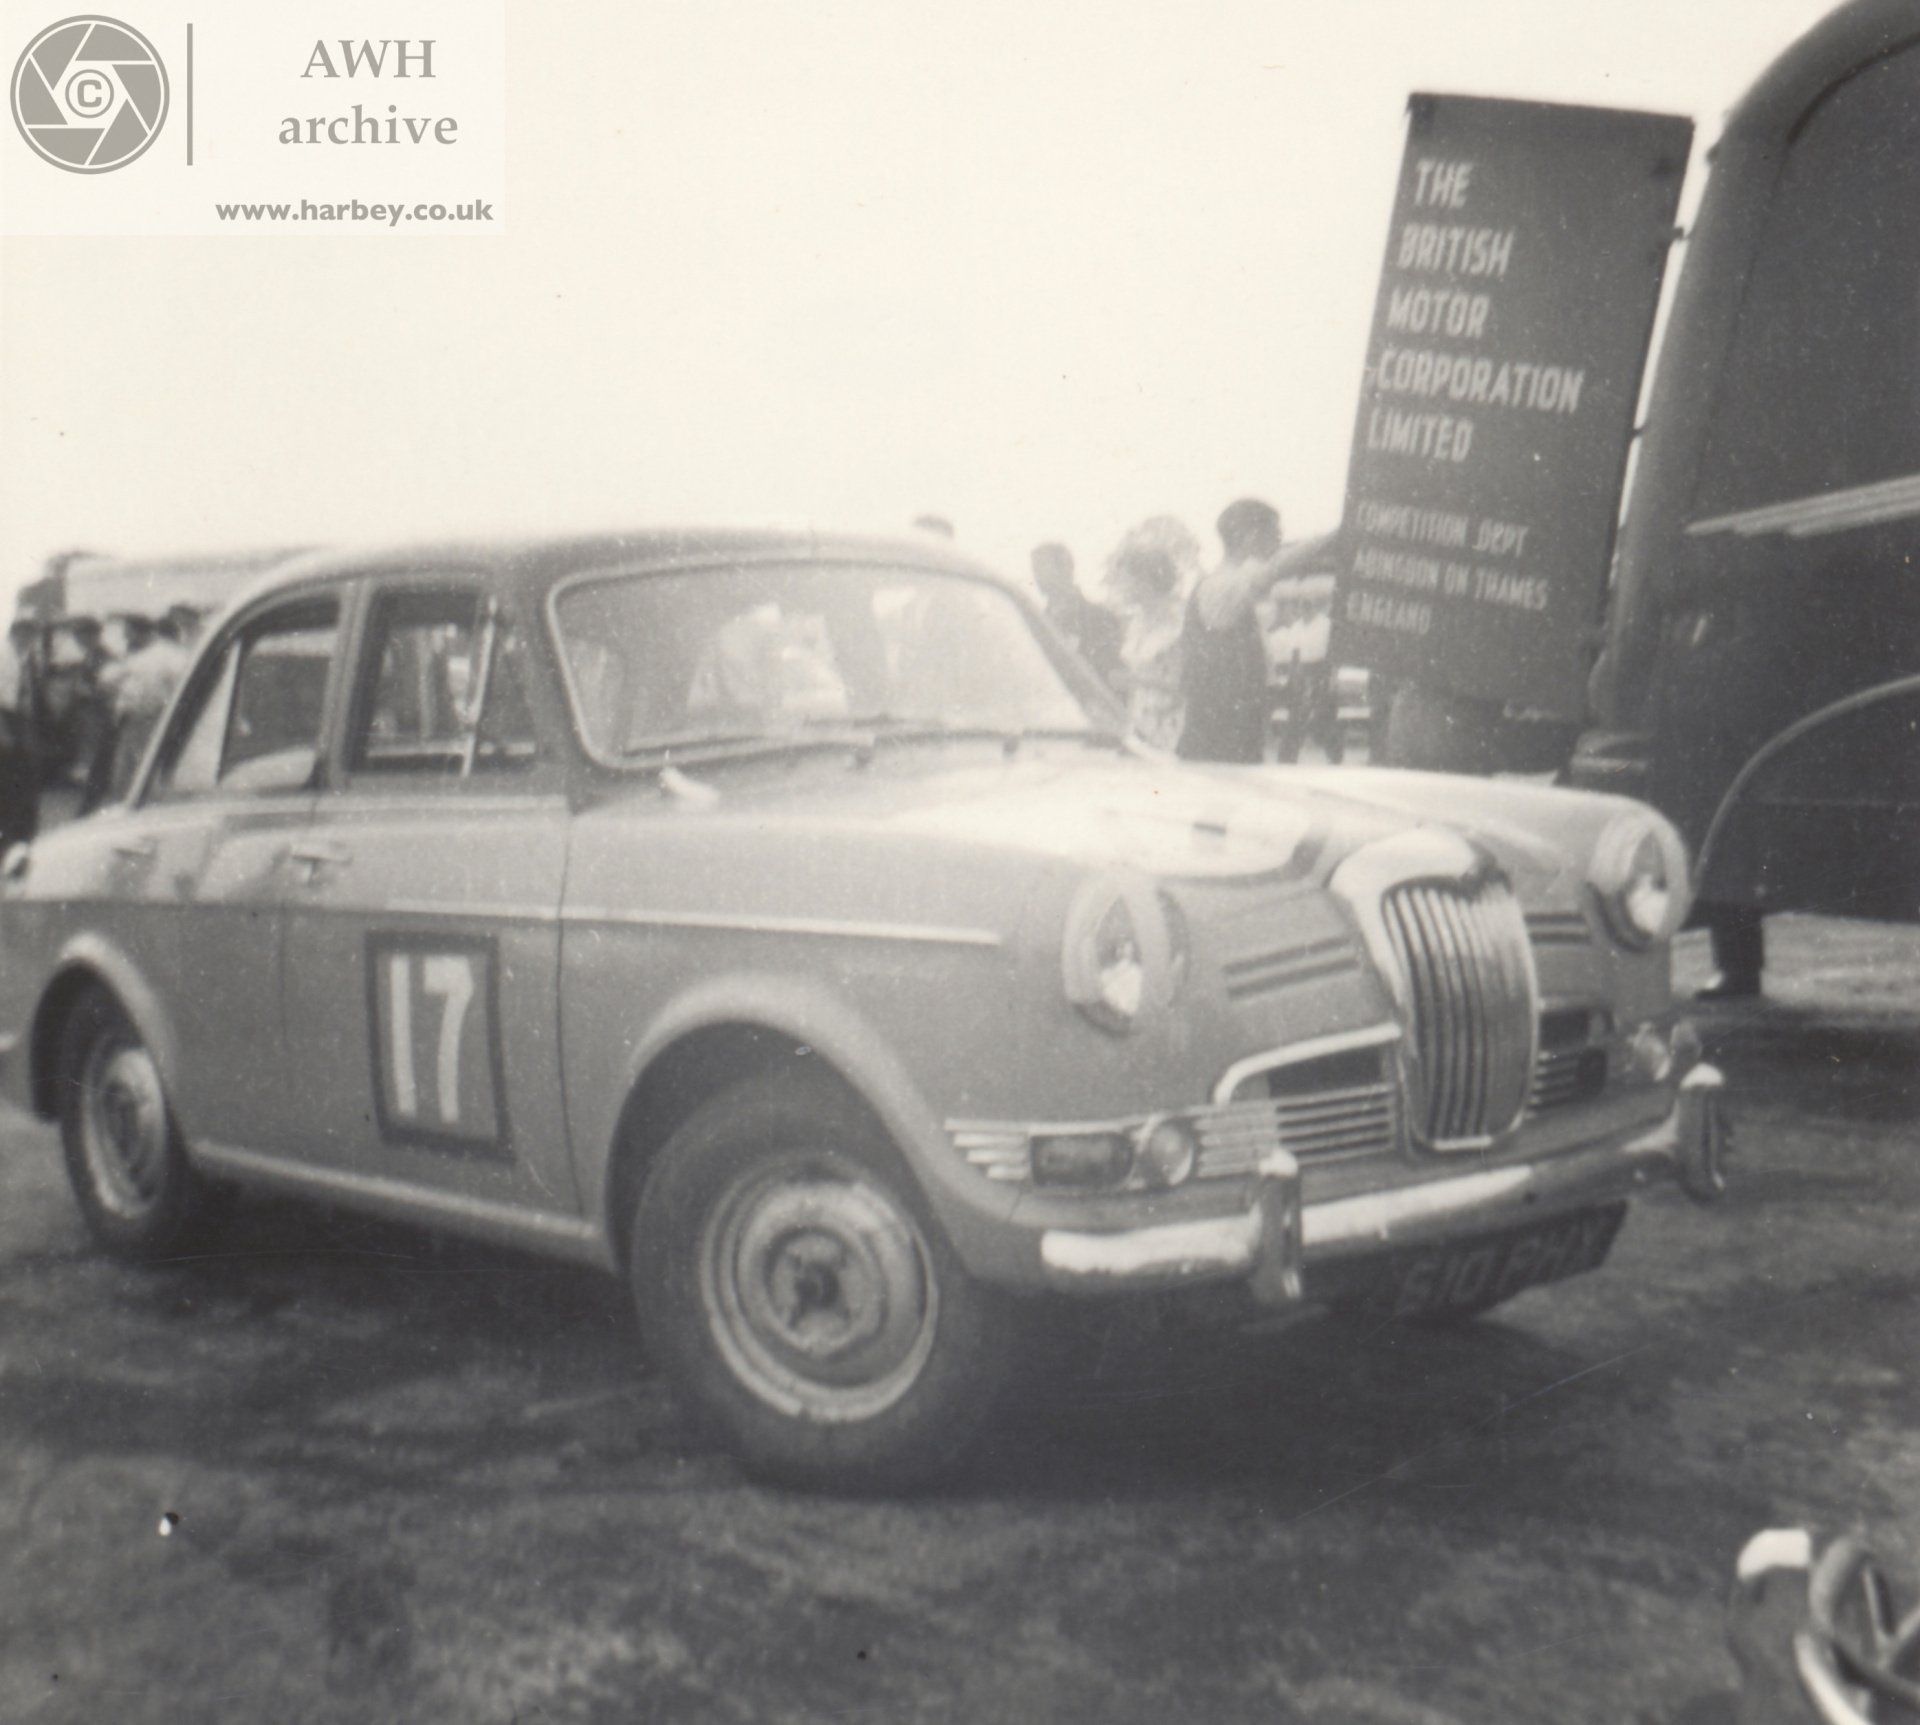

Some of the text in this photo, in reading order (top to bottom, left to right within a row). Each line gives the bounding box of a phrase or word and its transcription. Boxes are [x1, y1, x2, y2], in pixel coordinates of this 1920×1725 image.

[1413, 159, 1474, 209] THE
[1397, 221, 1515, 277] BRITISH
[1387, 285, 1490, 338] MOTOR
[1376, 348, 1586, 414] CORPORATION
[1366, 405, 1474, 462] LIMITED
[1355, 500, 1470, 548] COMPETITION
[1345, 589, 1433, 636] ENGLAND
[1444, 561, 1470, 595] ON
[1474, 566, 1550, 611] THAMES
[390, 954, 475, 1125] 17
